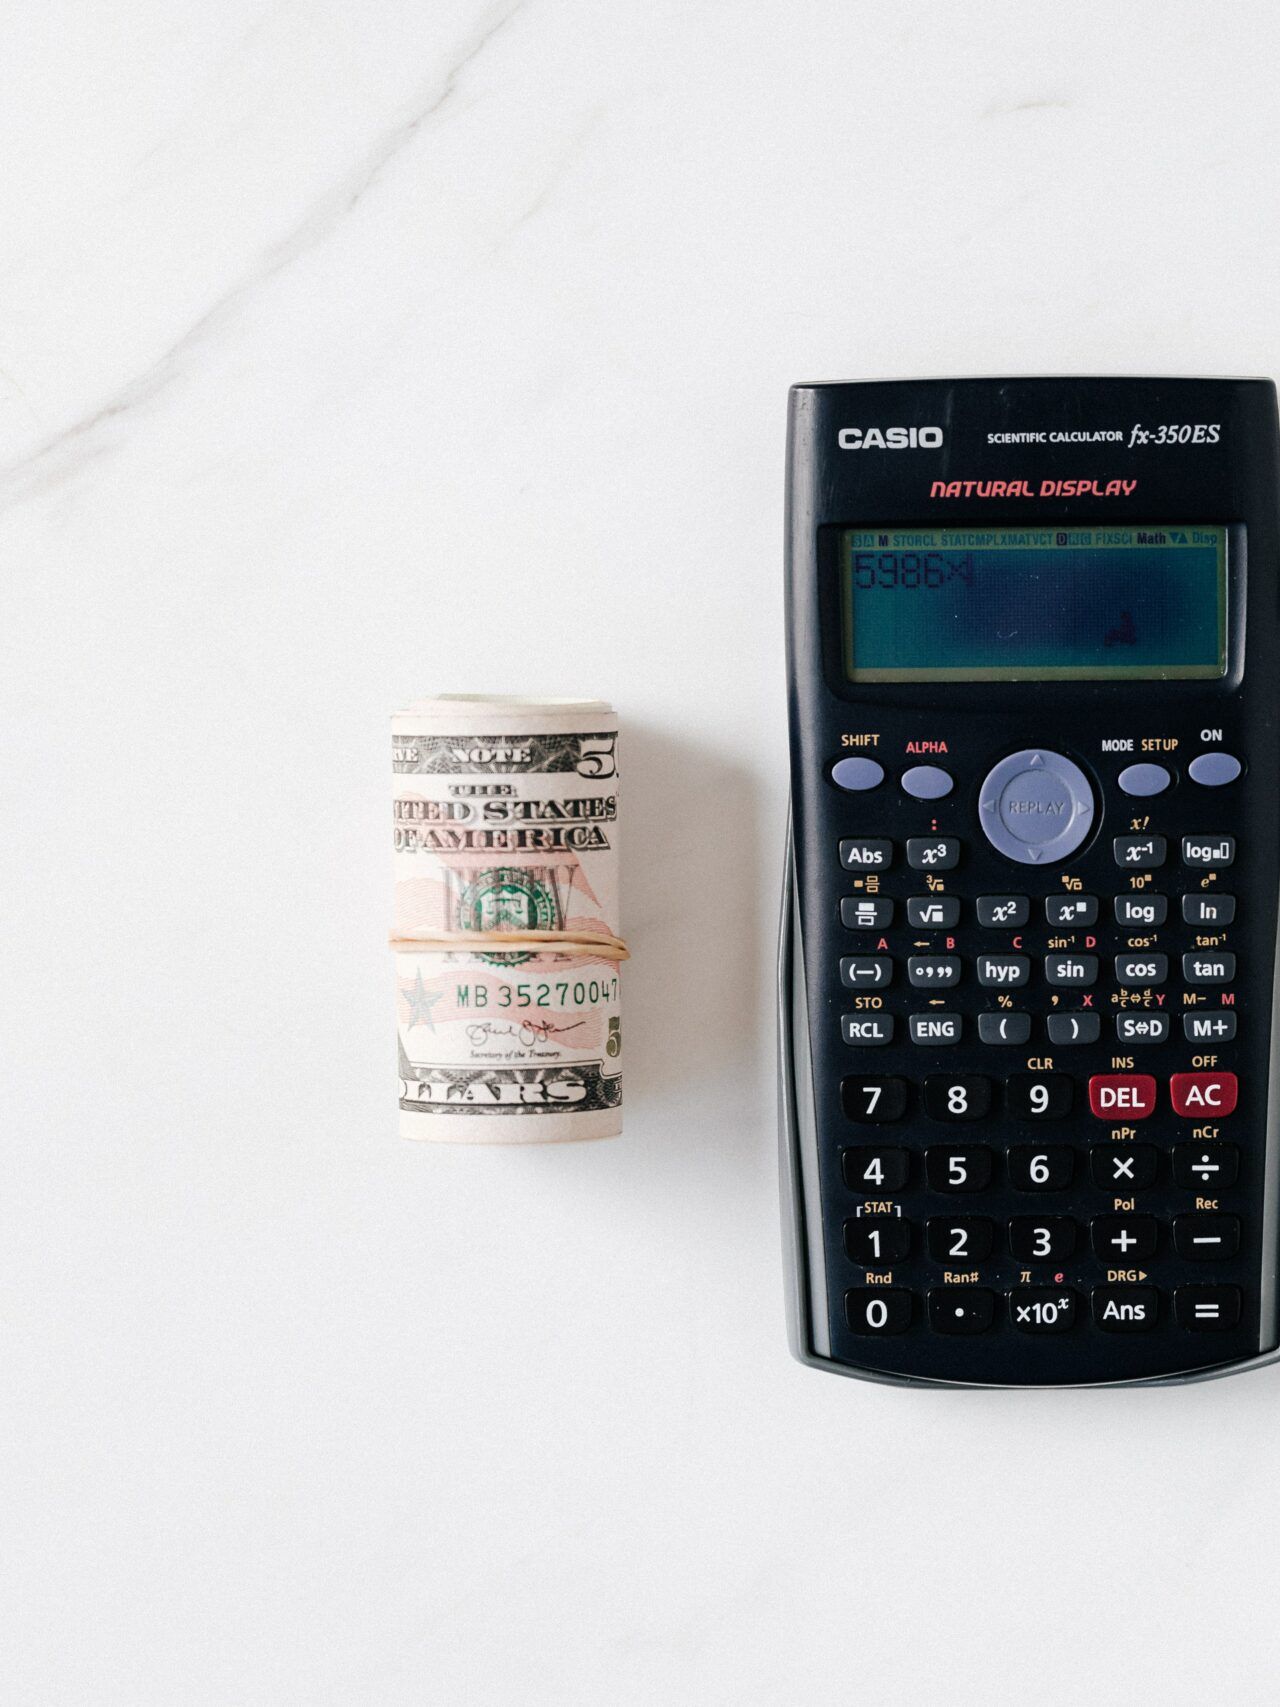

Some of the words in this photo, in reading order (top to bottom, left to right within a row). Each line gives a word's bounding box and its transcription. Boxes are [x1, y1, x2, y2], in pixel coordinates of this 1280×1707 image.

[838, 427, 943, 449] CASIO
[987, 432, 1047, 443] SCIENTIFIC
[1049, 430, 1123, 443] CALCULATOR
[1127, 424, 1221, 448] fx-350ES
[930, 480, 1034, 497] NATURAL
[1040, 480, 1137, 496] DISPLAY
[1137, 532, 1166, 545] Math
[842, 735, 880, 746] SHIFT
[1201, 729, 1222, 741] ON
[906, 742, 947, 753] ALPHA
[1102, 739, 1133, 751] MODE
[453, 747, 531, 764] NOTE
[576, 737, 616, 780] 5
[482, 796, 617, 823] STATES
[1009, 800, 1064, 815] REPLAY
[848, 848, 882, 863] Abs
[1126, 902, 1154, 922] log
[1201, 903, 1216, 919] ln
[878, 938, 887, 949] A
[947, 938, 954, 949] B
[1013, 937, 1022, 948] C
[1086, 936, 1096, 947] D
[986, 961, 1020, 982] hyp
[1057, 960, 1084, 977] sin
[1126, 964, 1156, 976] cos
[1193, 962, 1224, 976] tan
[856, 997, 882, 1008] STO
[1083, 995, 1092, 1006] X
[1156, 994, 1165, 1005] Y
[1222, 994, 1234, 1004] M
[850, 1023, 883, 1037] RCL
[917, 1022, 954, 1037] ENG
[1194, 1020, 1227, 1036] M+
[1028, 1058, 1054, 1069] CLR
[1112, 1057, 1134, 1068] INS
[1192, 1056, 1217, 1067] OFF
[400, 1080, 587, 1104] LLARS
[1030, 1085, 1048, 1113] 9
[1101, 1088, 1145, 1107] DEL
[1185, 1084, 1221, 1106] AC
[863, 1087, 881, 1114] 7
[948, 1086, 967, 1113] 8
[1112, 1128, 1136, 1139] nPr
[1193, 1126, 1219, 1138] nCr
[864, 1158, 884, 1185] 4
[949, 1157, 966, 1184] 5
[1030, 1155, 1049, 1183] 6
[863, 1202, 892, 1213] STAT
[1115, 1198, 1134, 1210] Pol
[1196, 1198, 1218, 1209] Rec
[869, 1231, 880, 1257] 1
[949, 1229, 967, 1256] 2
[1033, 1228, 1051, 1256] 3
[866, 1272, 891, 1283] Rnd
[944, 1272, 978, 1283] Ran#
[1055, 1273, 1063, 1282] e
[1108, 1270, 1136, 1281] DRG
[866, 1300, 887, 1327] 0
[1103, 1301, 1145, 1320] Ans
